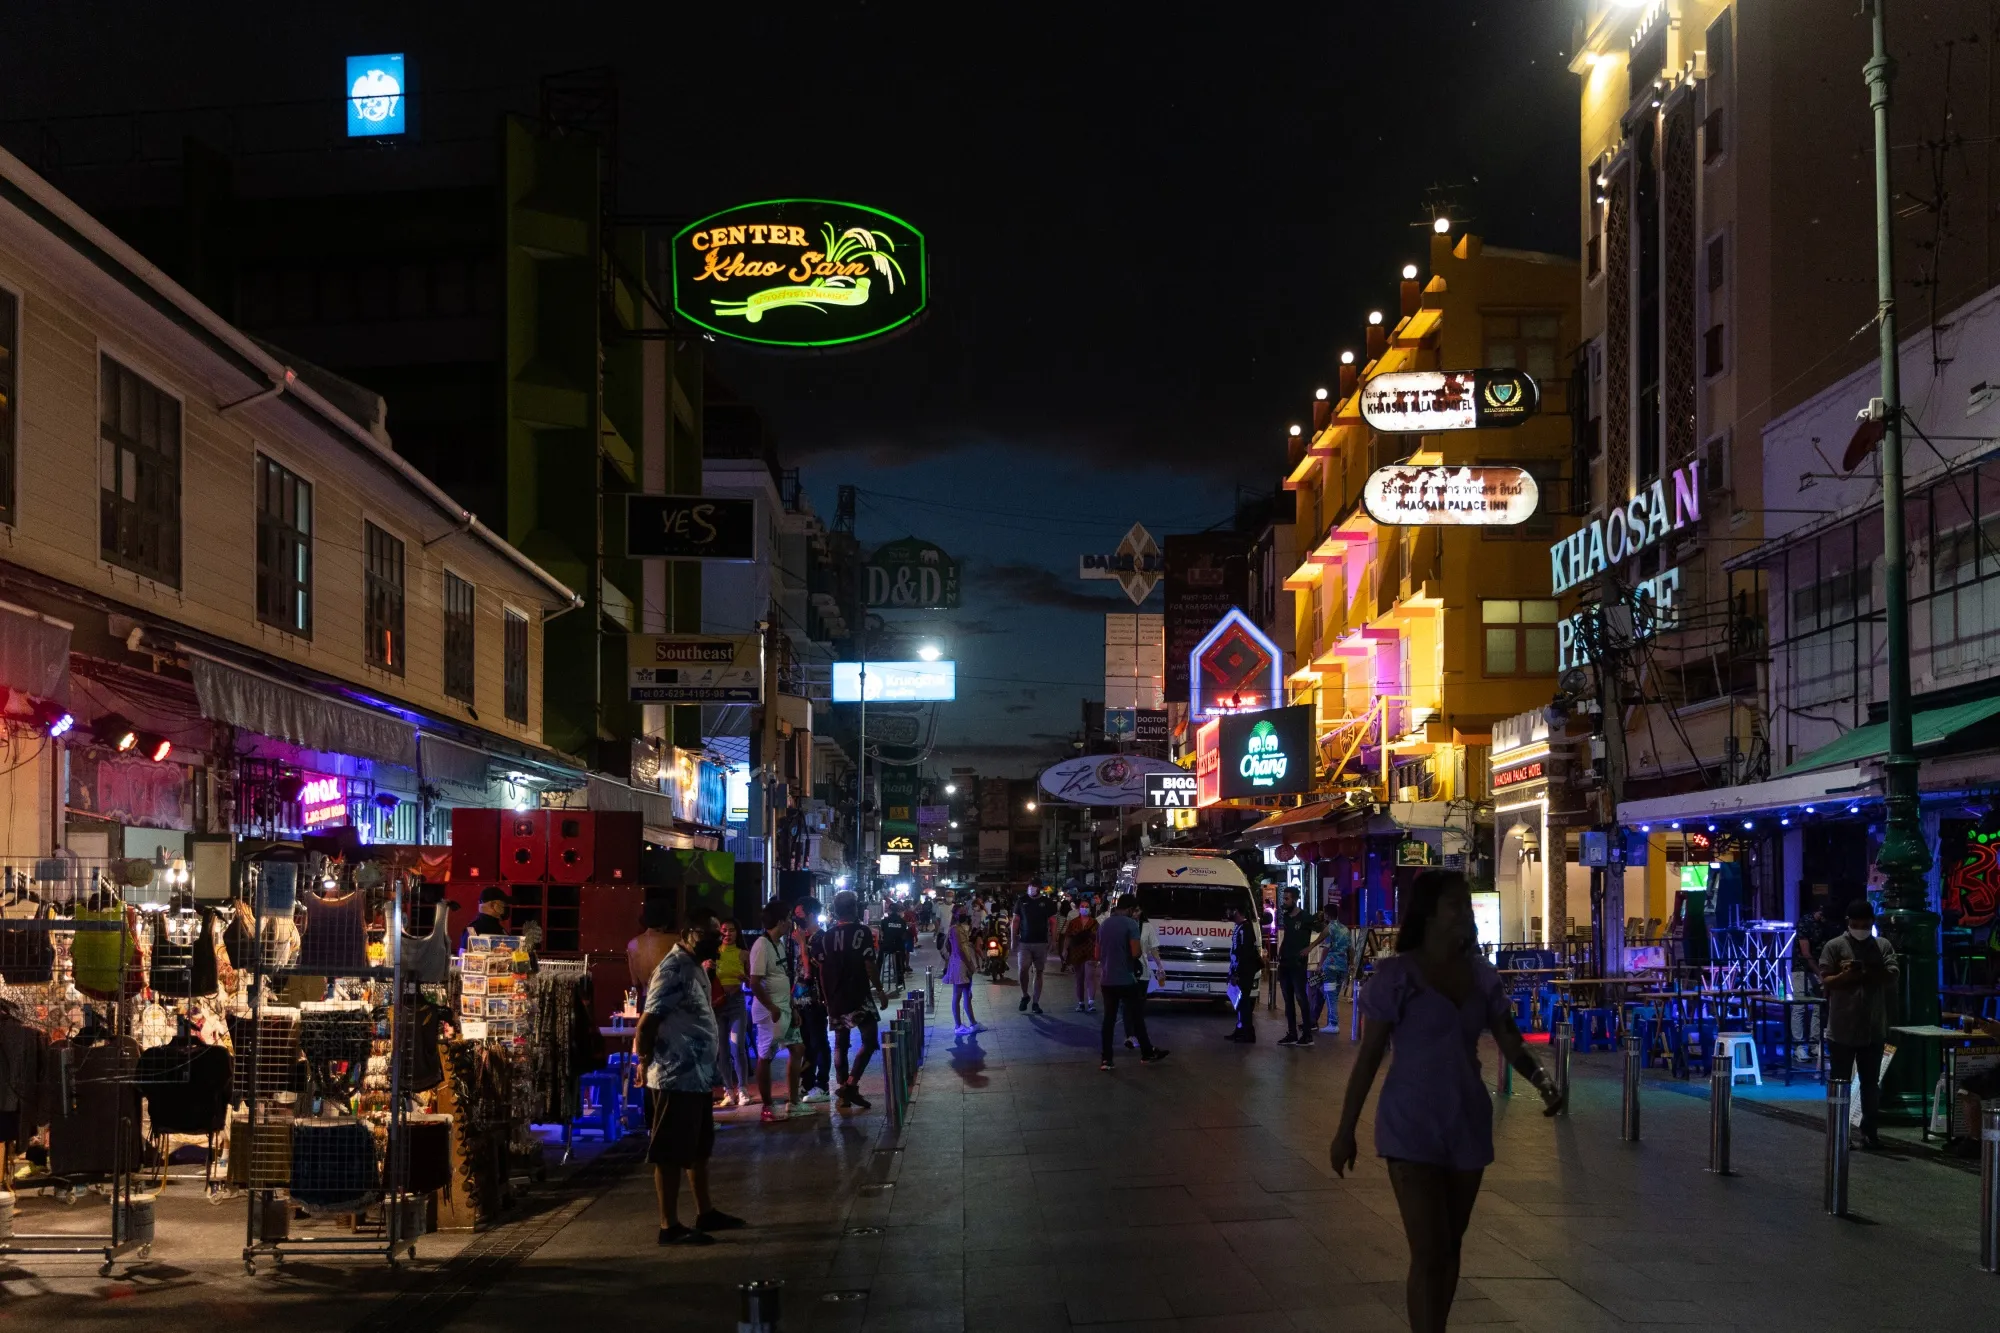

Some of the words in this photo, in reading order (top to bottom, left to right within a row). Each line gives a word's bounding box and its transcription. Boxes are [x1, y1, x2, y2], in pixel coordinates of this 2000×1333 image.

[692, 224, 809, 251] CENTER
[693, 248, 784, 282] Khao
[789, 252, 870, 283] Sarn
[1367, 402, 1408, 415] KHAOSAN
[1395, 500, 1446, 511] KHAOSAN
[1448, 500, 1487, 511] PALACE
[1489, 500, 1508, 511] INN
[661, 503, 717, 545] YES
[1549, 459, 1702, 597] KHAOSAN
[866, 565, 942, 607] D&D
[945, 566, 958, 605] INN
[1557, 566, 1679, 673] PACE
[656, 645, 734, 661] Southeast
[1137, 726, 1167, 735] CLINIC
[1240, 754, 1287, 778] Chang
[1494, 771, 1513, 787] KHAOSAN
[1512, 767, 1527, 782] PALACE
[1528, 763, 1542, 778] HOTEL
[1056, 765, 1101, 796] The
[1162, 777, 1197, 789] BIGG
[1150, 790, 1197, 806] TAT
